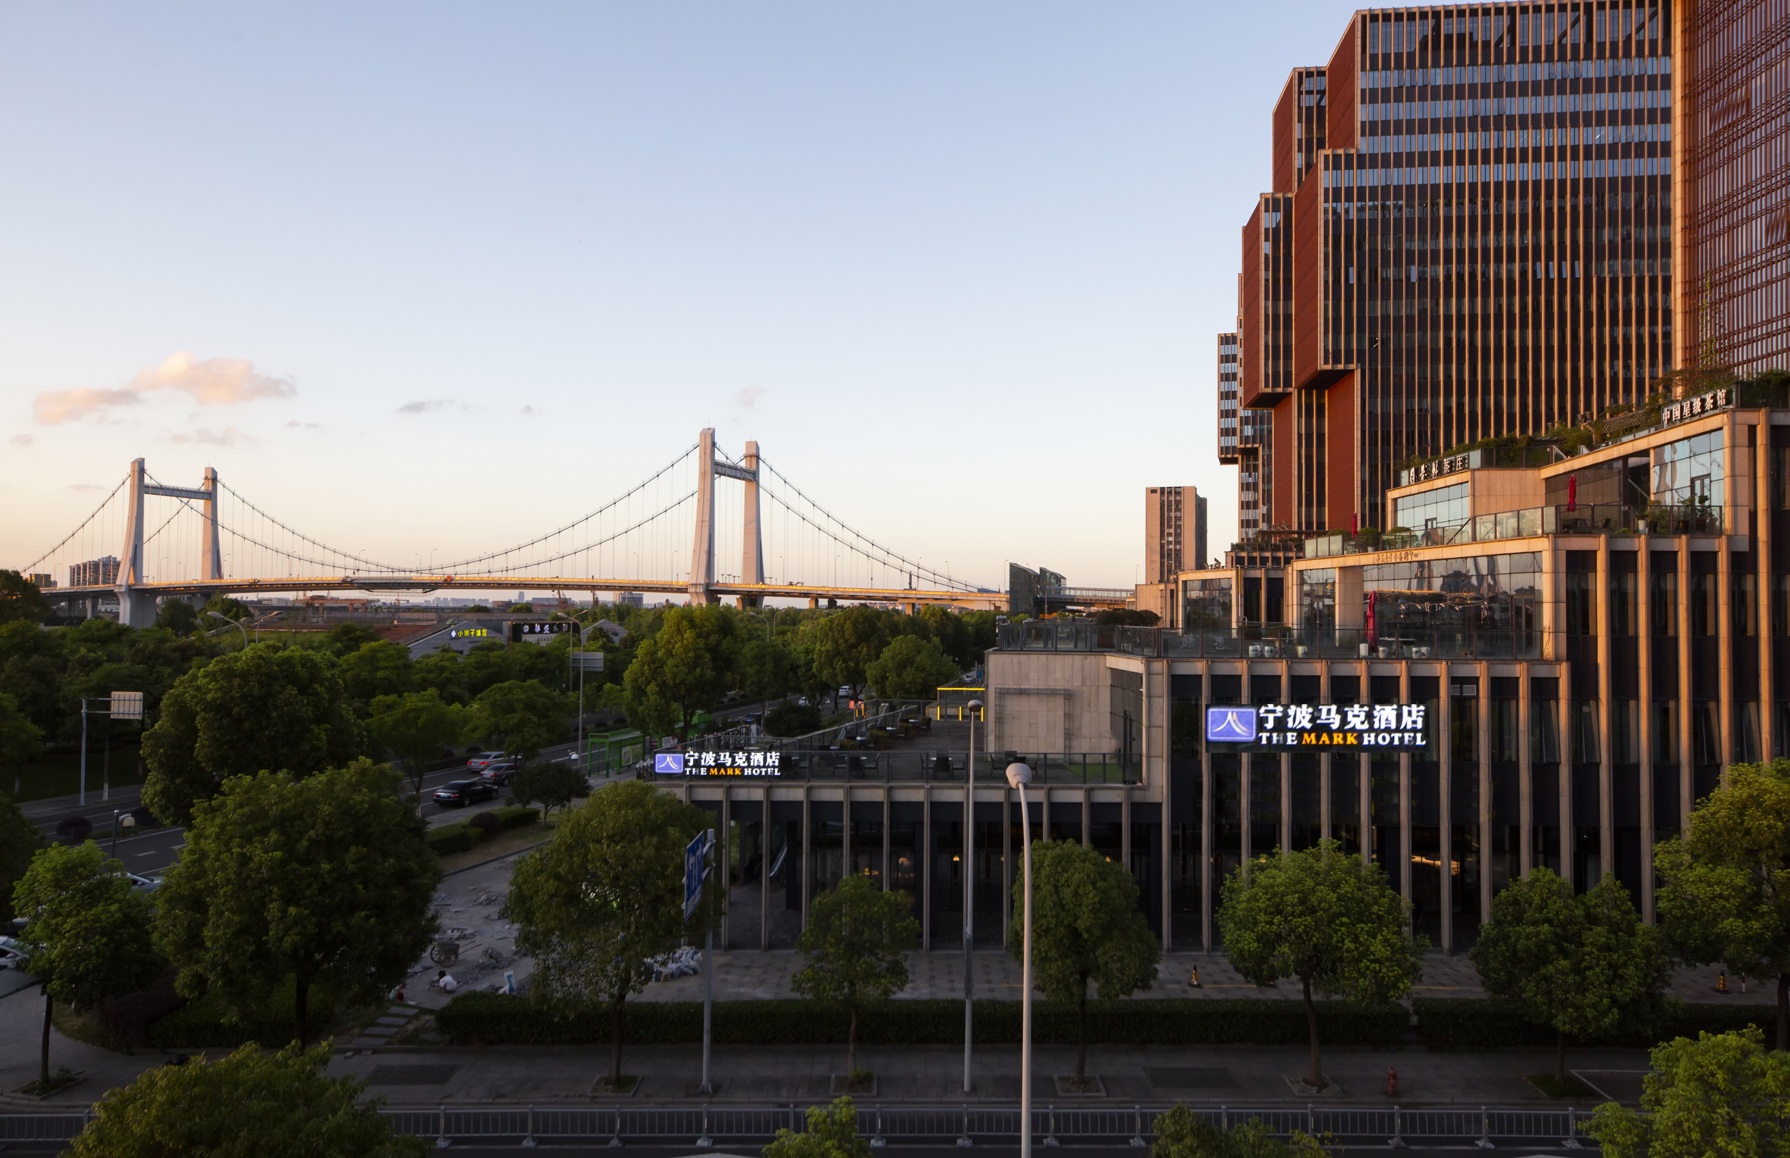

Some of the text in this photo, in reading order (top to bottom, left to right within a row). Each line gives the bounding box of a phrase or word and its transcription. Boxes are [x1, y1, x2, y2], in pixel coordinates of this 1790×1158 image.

[1662, 388, 1727, 424] 中国星级茶馆
[1258, 704, 1426, 730] 宁波马克酒店
[1258, 732, 1426, 745] THE MARK HOTEL
[684, 751, 780, 767] 宁波马克酒店
[684, 767, 781, 775] THE MARK HOTEL
